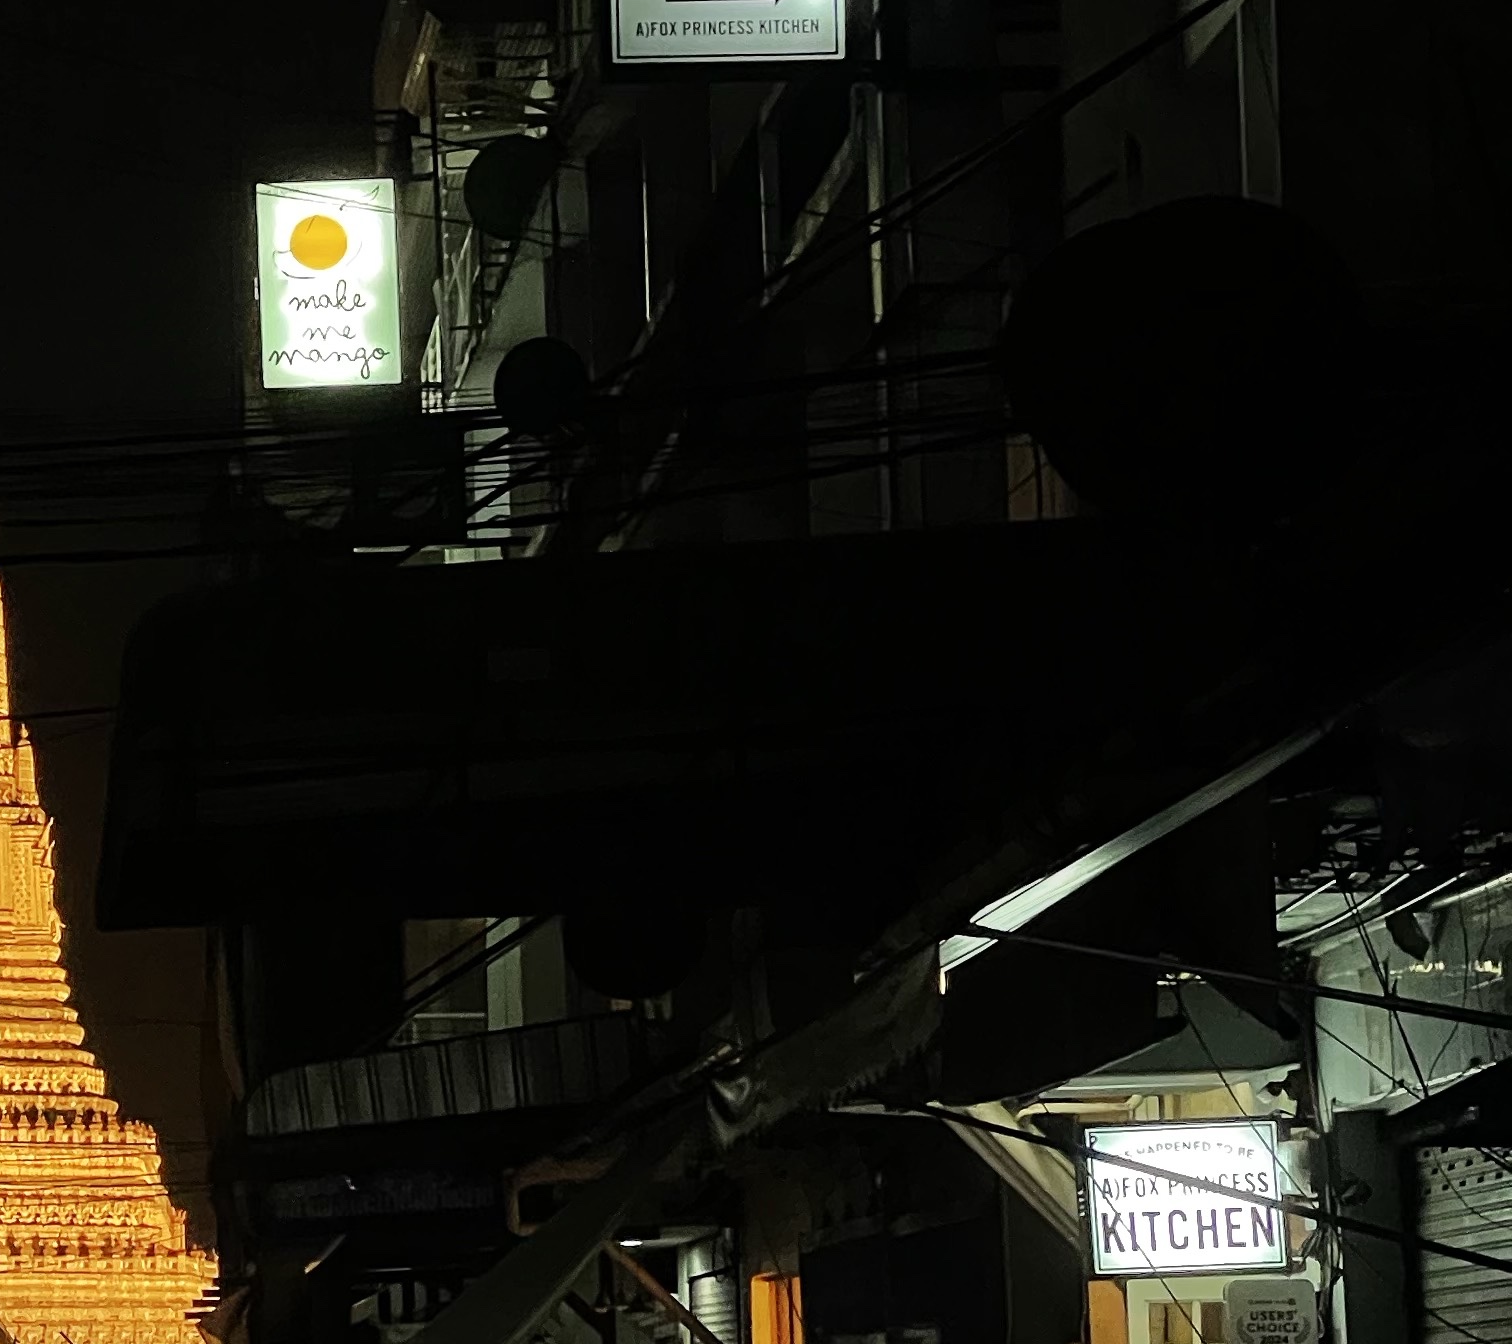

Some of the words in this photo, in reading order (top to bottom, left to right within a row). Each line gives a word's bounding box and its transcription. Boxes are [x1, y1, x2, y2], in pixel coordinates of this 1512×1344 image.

[636, 20, 678, 38] A)FOX
[682, 20, 755, 37] PRINCESS
[759, 18, 820, 35] KITCHEN
[289, 279, 367, 312] make
[302, 325, 356, 341] me
[268, 347, 391, 379] mango
[1101, 1206, 1276, 1254] KITCHEN
[1246, 1322, 1300, 1333] CHOICE
